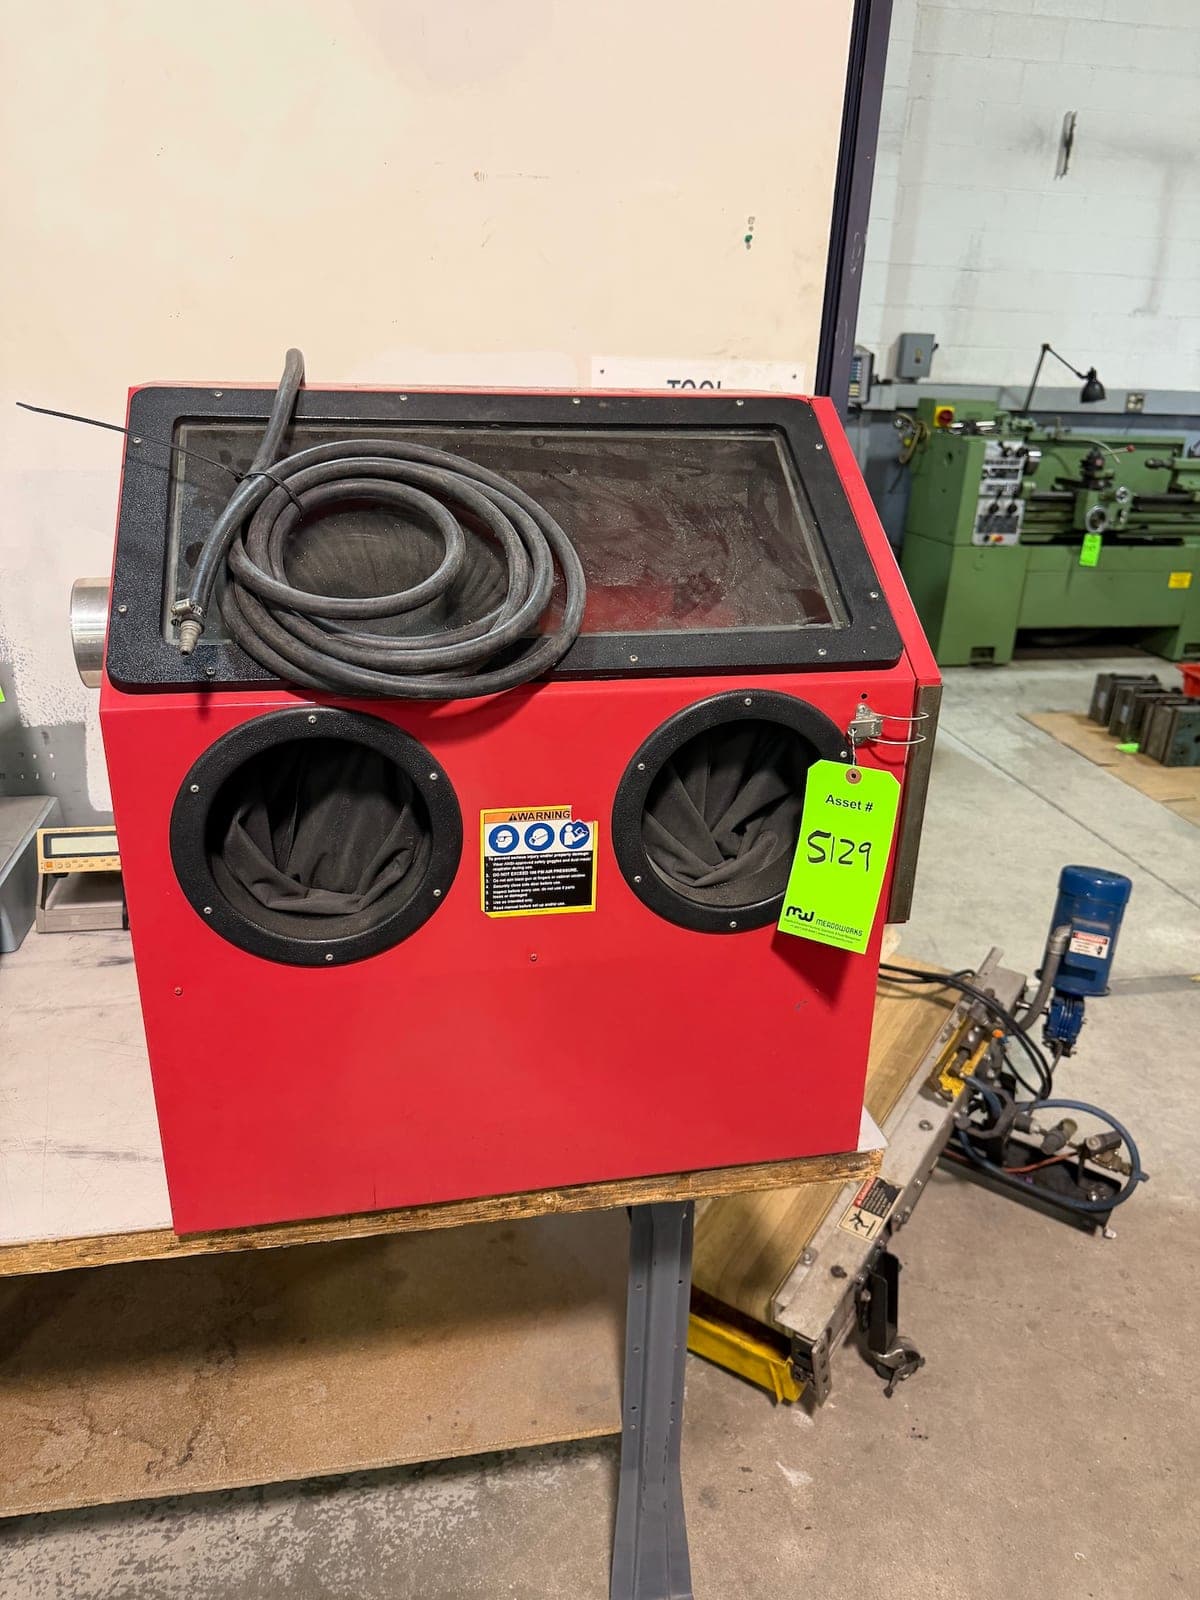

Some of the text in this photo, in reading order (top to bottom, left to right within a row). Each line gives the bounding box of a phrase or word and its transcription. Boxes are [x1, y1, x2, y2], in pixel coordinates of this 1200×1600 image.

[825, 794, 873, 812] Asset #
[518, 810, 570, 821] WARNING
[816, 918, 863, 936] MEADOWORKS
